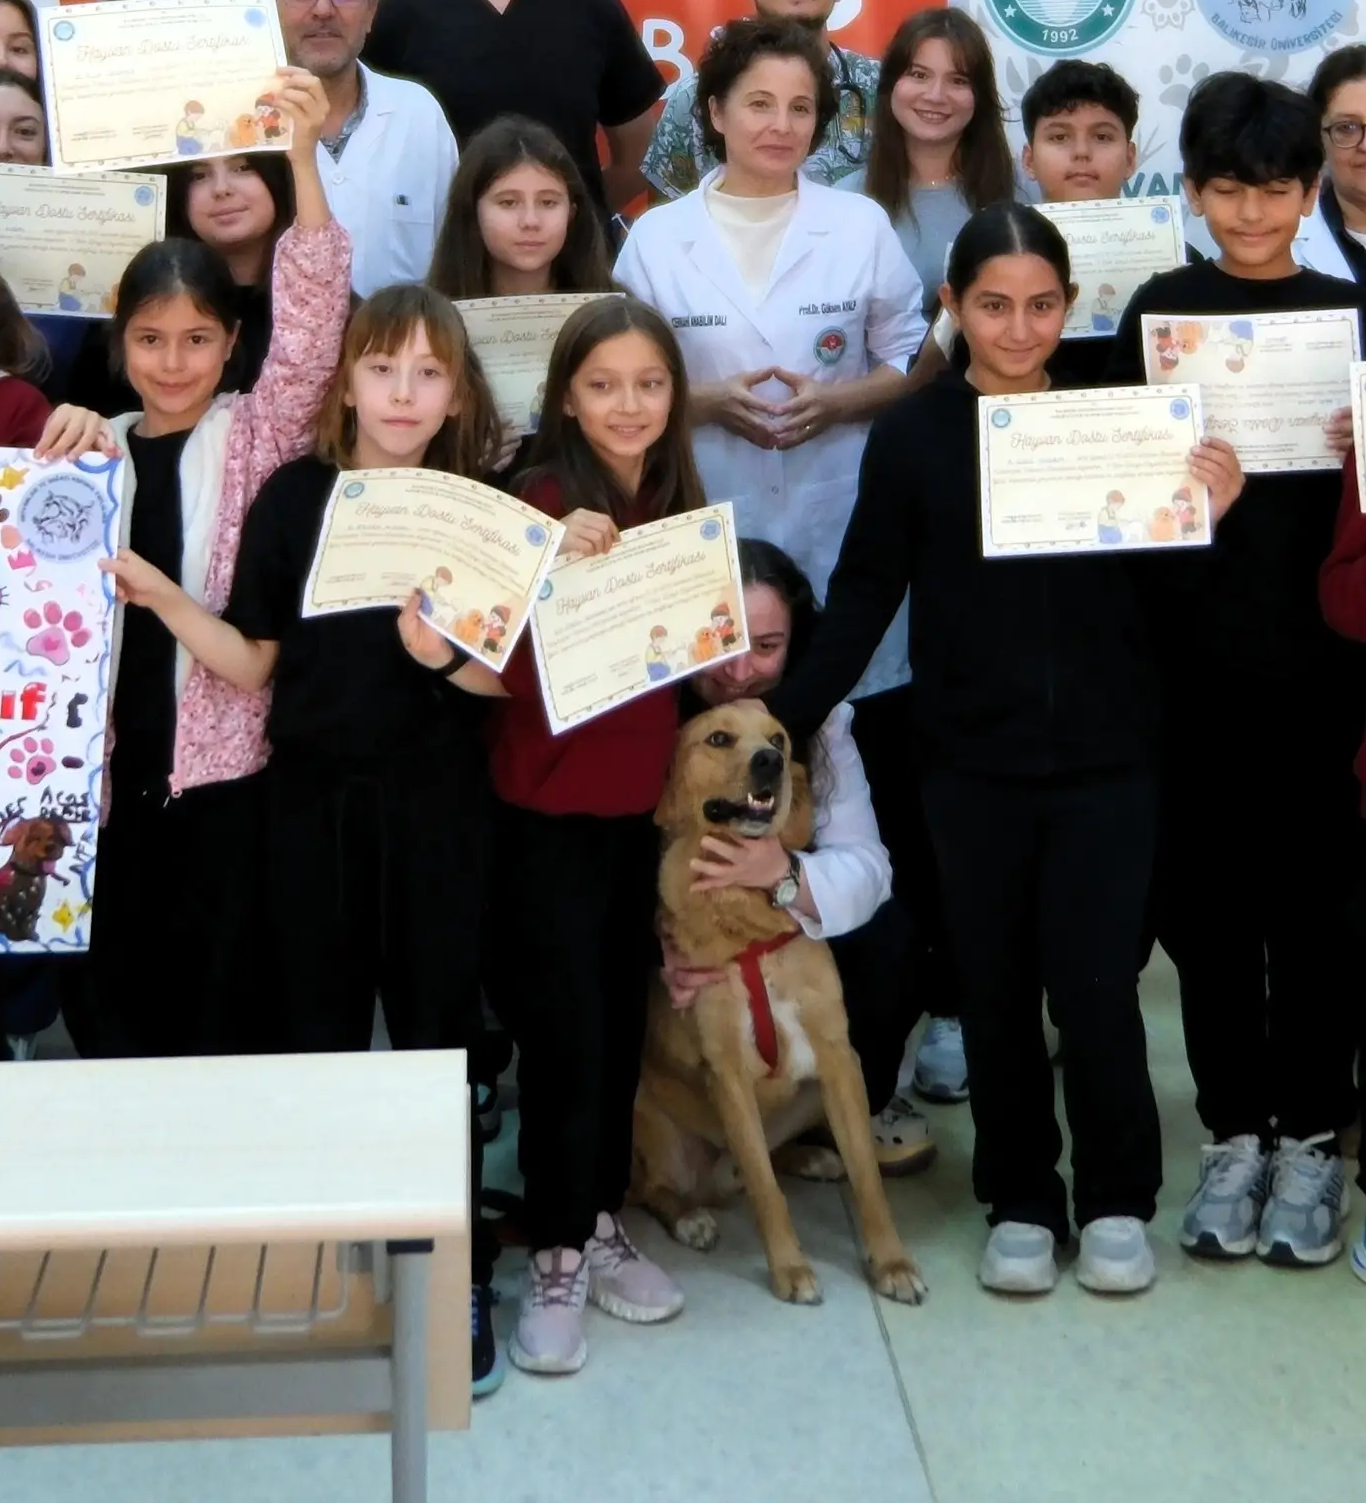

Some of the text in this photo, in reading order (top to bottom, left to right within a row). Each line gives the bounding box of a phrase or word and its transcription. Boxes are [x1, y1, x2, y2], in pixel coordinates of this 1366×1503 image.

[1042, 29, 1079, 43] 1992
[1211, 10, 1343, 50] BALIKESİR ÜNİVERSİTESİ
